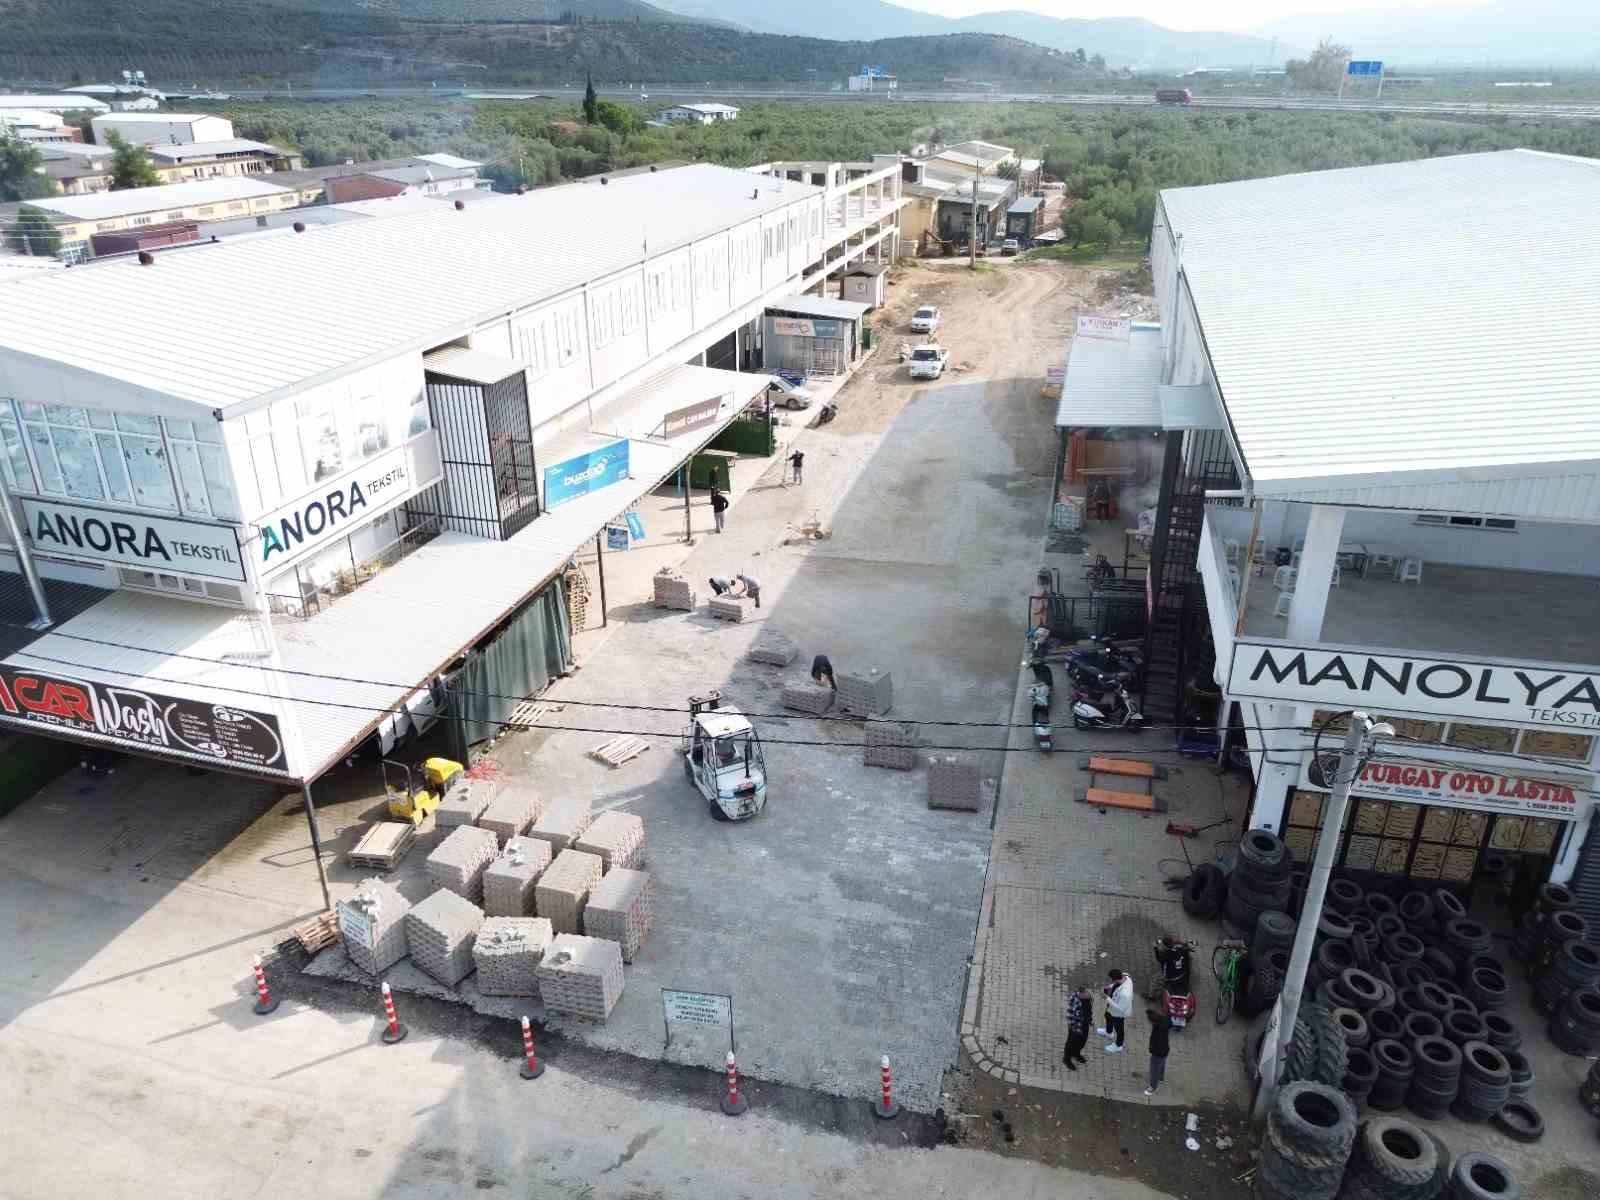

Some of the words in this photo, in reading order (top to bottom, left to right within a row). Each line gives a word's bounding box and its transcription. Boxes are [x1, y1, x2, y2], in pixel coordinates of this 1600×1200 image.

[37, 510, 172, 561] ANORA
[171, 540, 237, 564] TEKSTİL
[262, 480, 367, 562] ANORA
[1250, 649, 1600, 713] MANOLYA
[14, 677, 96, 722] CAR
[87, 681, 170, 746] Wash
[26, 711, 96, 732] PREMIUM
[1360, 763, 1449, 790] TURGAY
[1449, 772, 1494, 795] OTO
